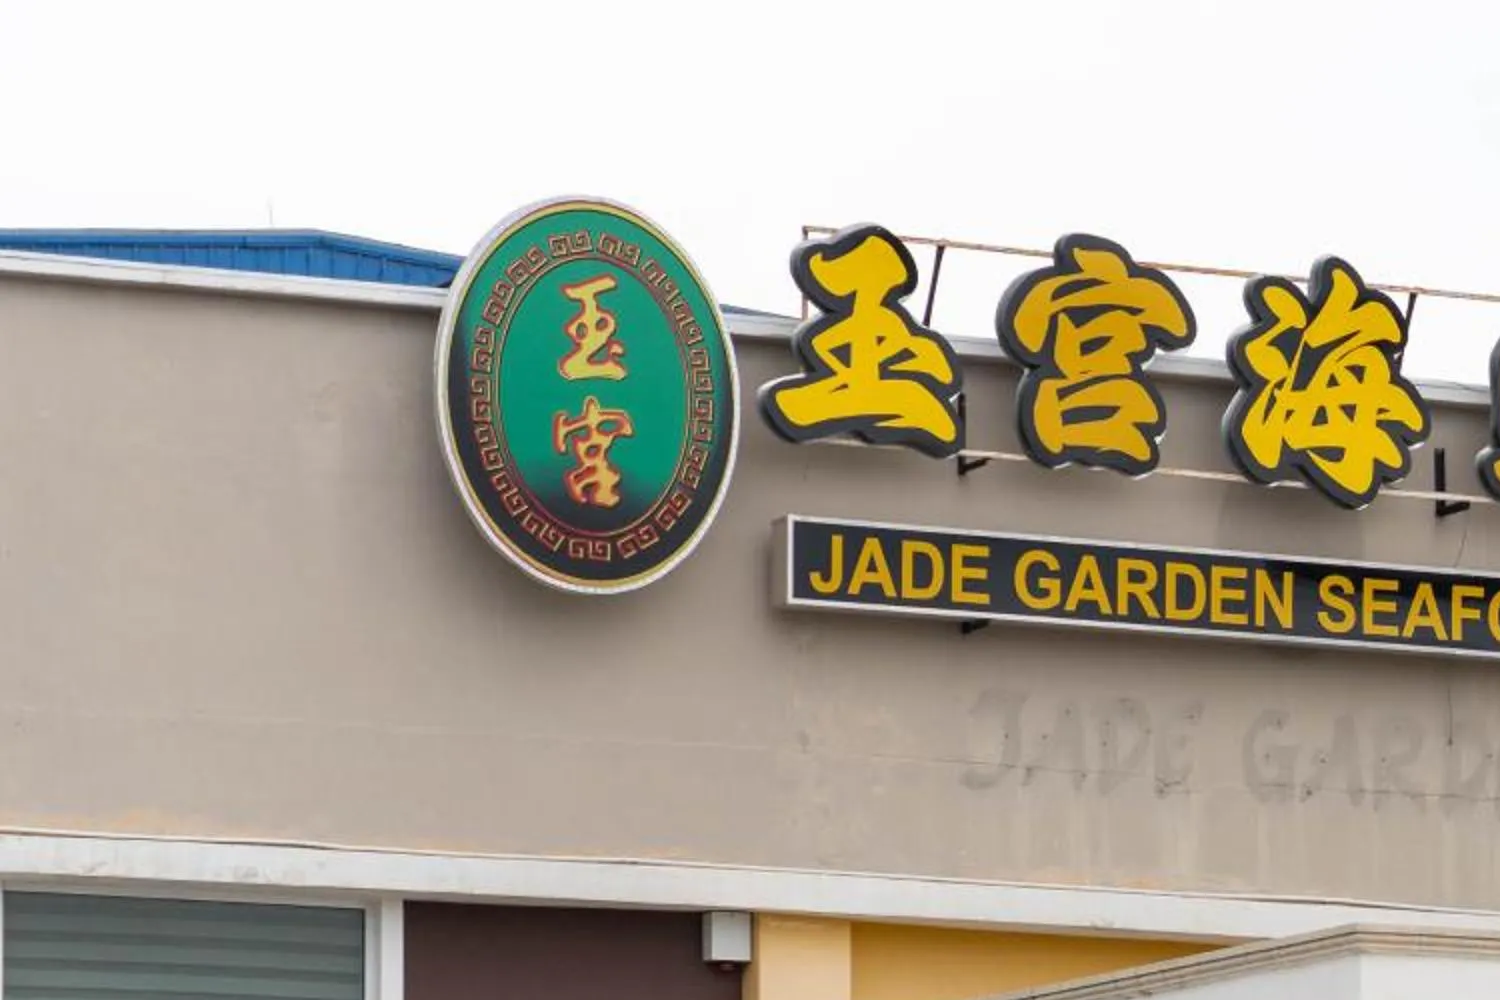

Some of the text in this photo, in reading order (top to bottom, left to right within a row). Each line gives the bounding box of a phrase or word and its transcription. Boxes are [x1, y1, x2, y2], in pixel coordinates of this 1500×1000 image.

[810, 536, 990, 605] JADE
[1014, 549, 1293, 626] GARDEN
[958, 688, 1204, 800] JADE
